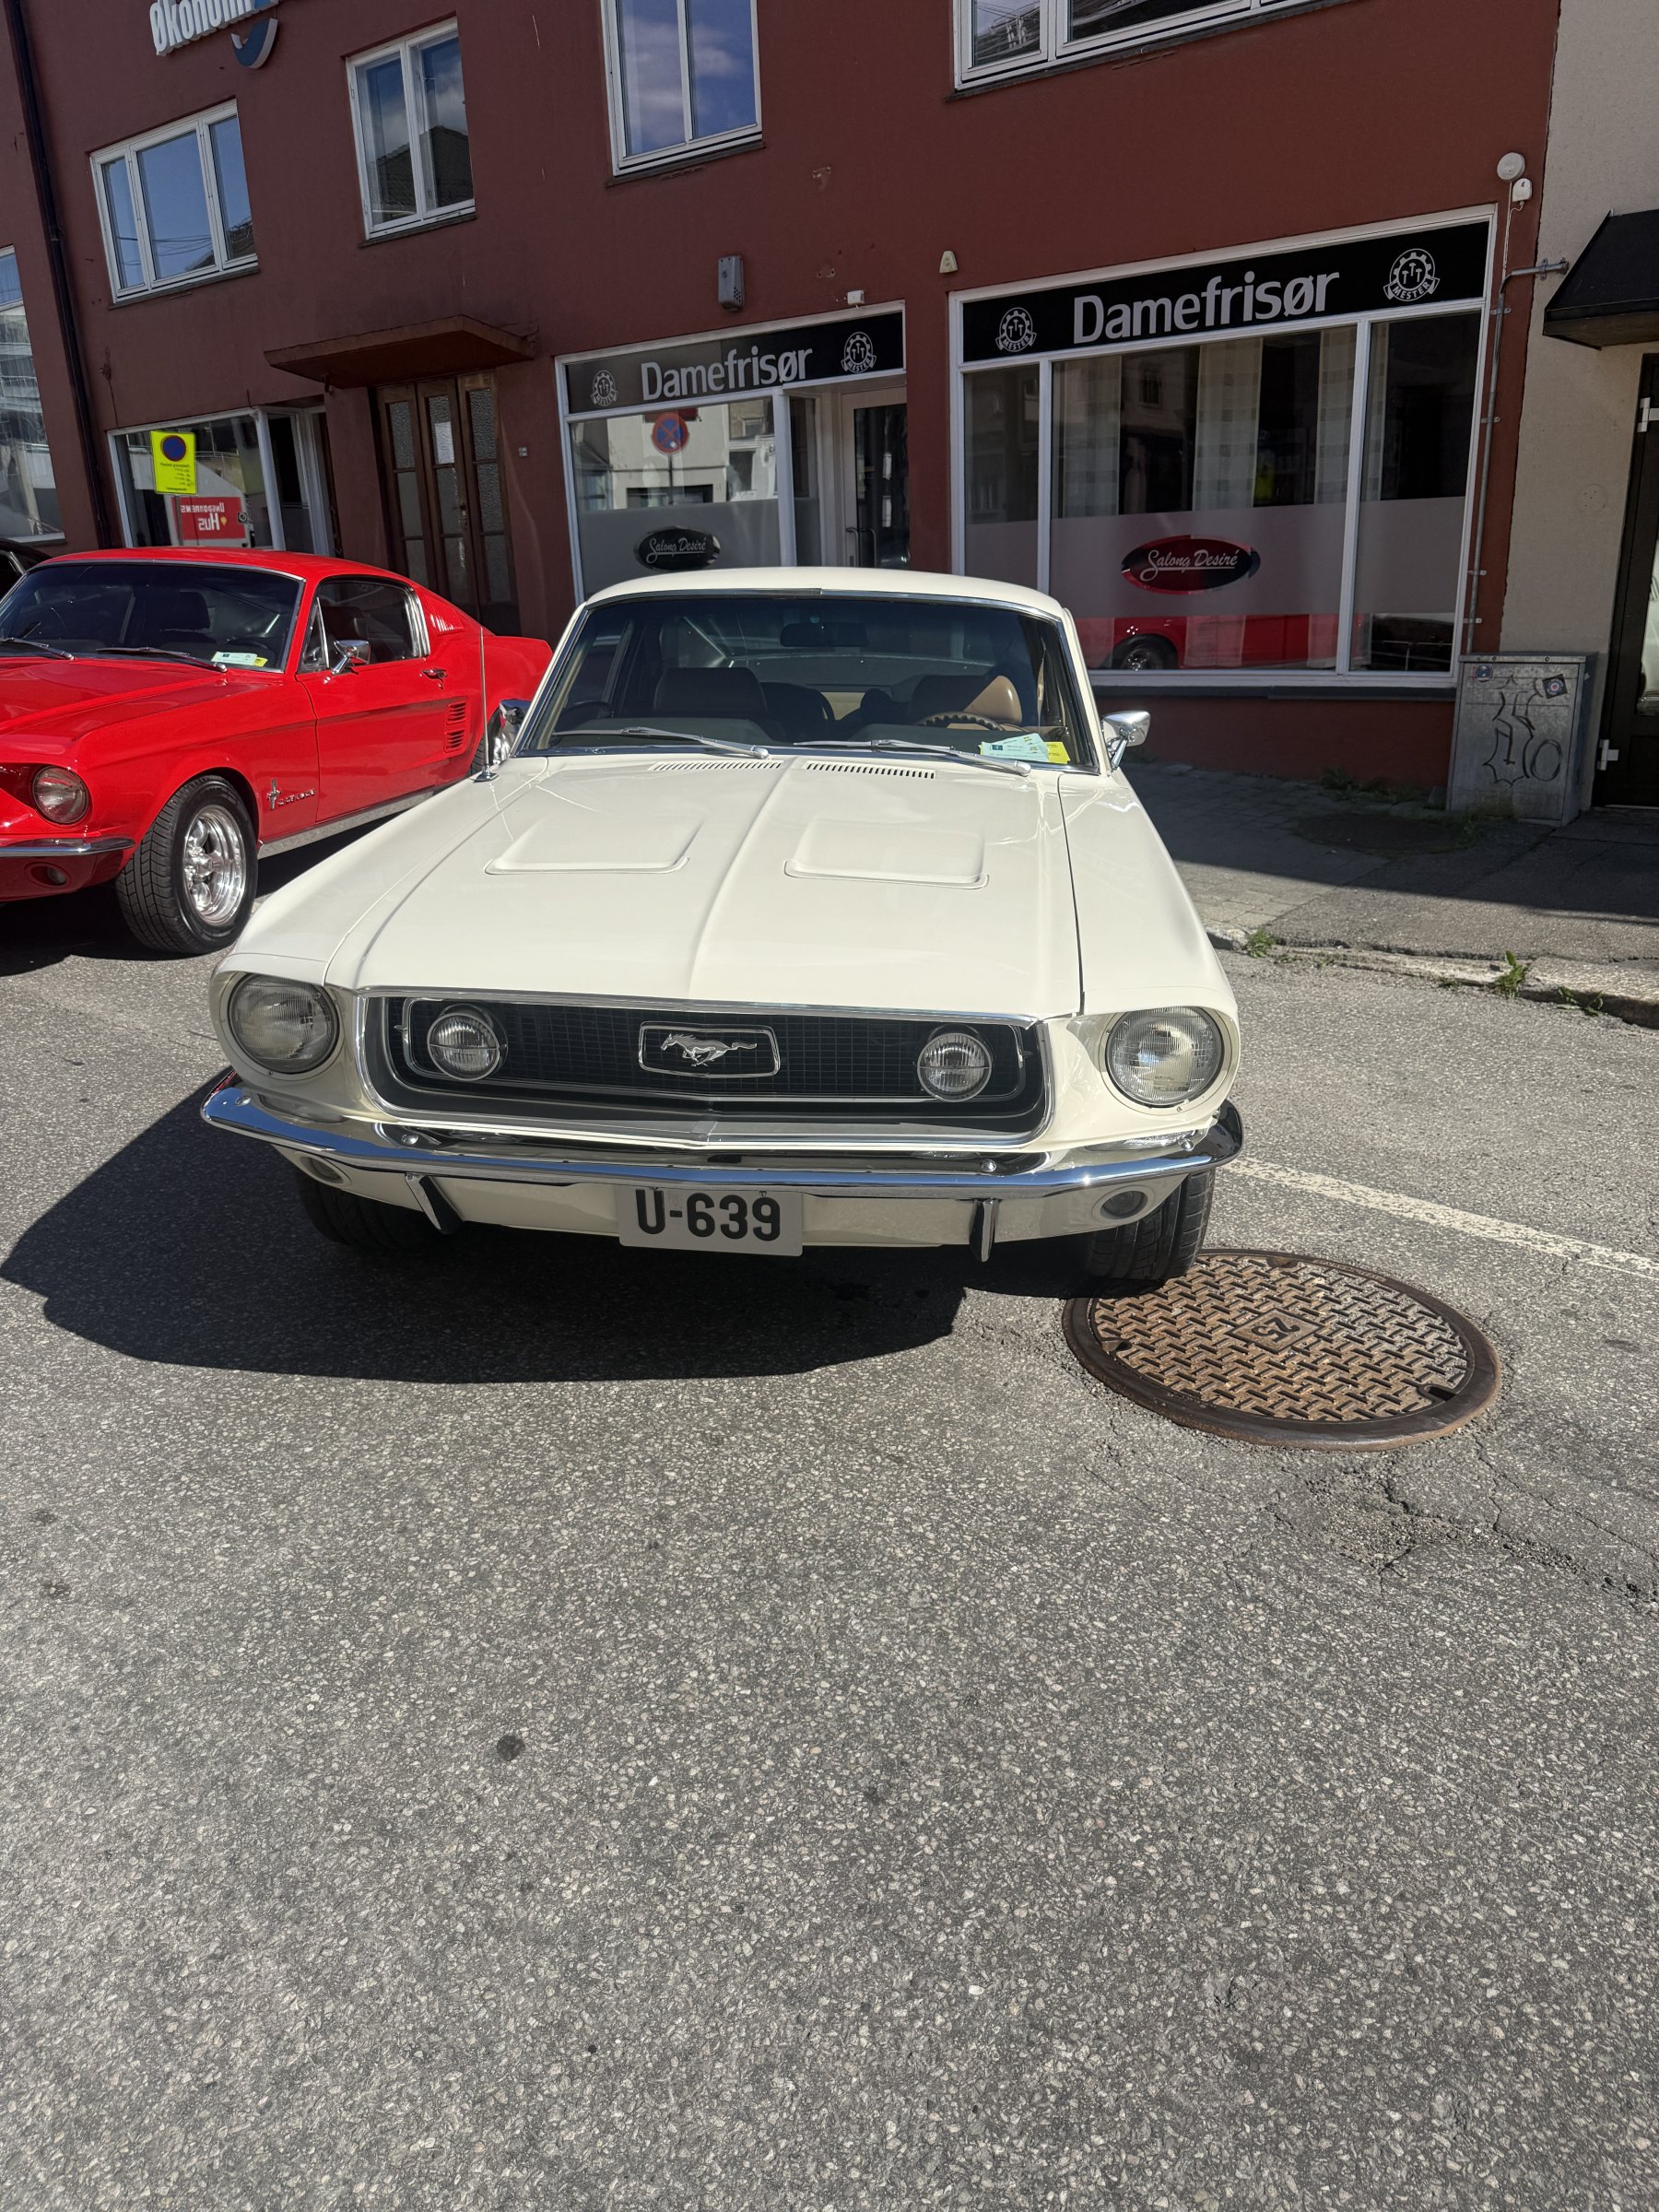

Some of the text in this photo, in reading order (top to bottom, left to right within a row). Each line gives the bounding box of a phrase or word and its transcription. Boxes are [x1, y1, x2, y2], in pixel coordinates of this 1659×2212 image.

[1393, 281, 1430, 300] MESTER
[1072, 271, 1340, 344] Damefrisør
[1003, 335, 1030, 350] MESTER
[641, 345, 813, 401] Damefrisør
[846, 358, 871, 372] MESTER
[646, 536, 706, 564] Salong Desiré
[1139, 548, 1240, 582] Salong Desiré
[635, 1189, 781, 1241] U-639
[1252, 1317, 1300, 1343] 25
